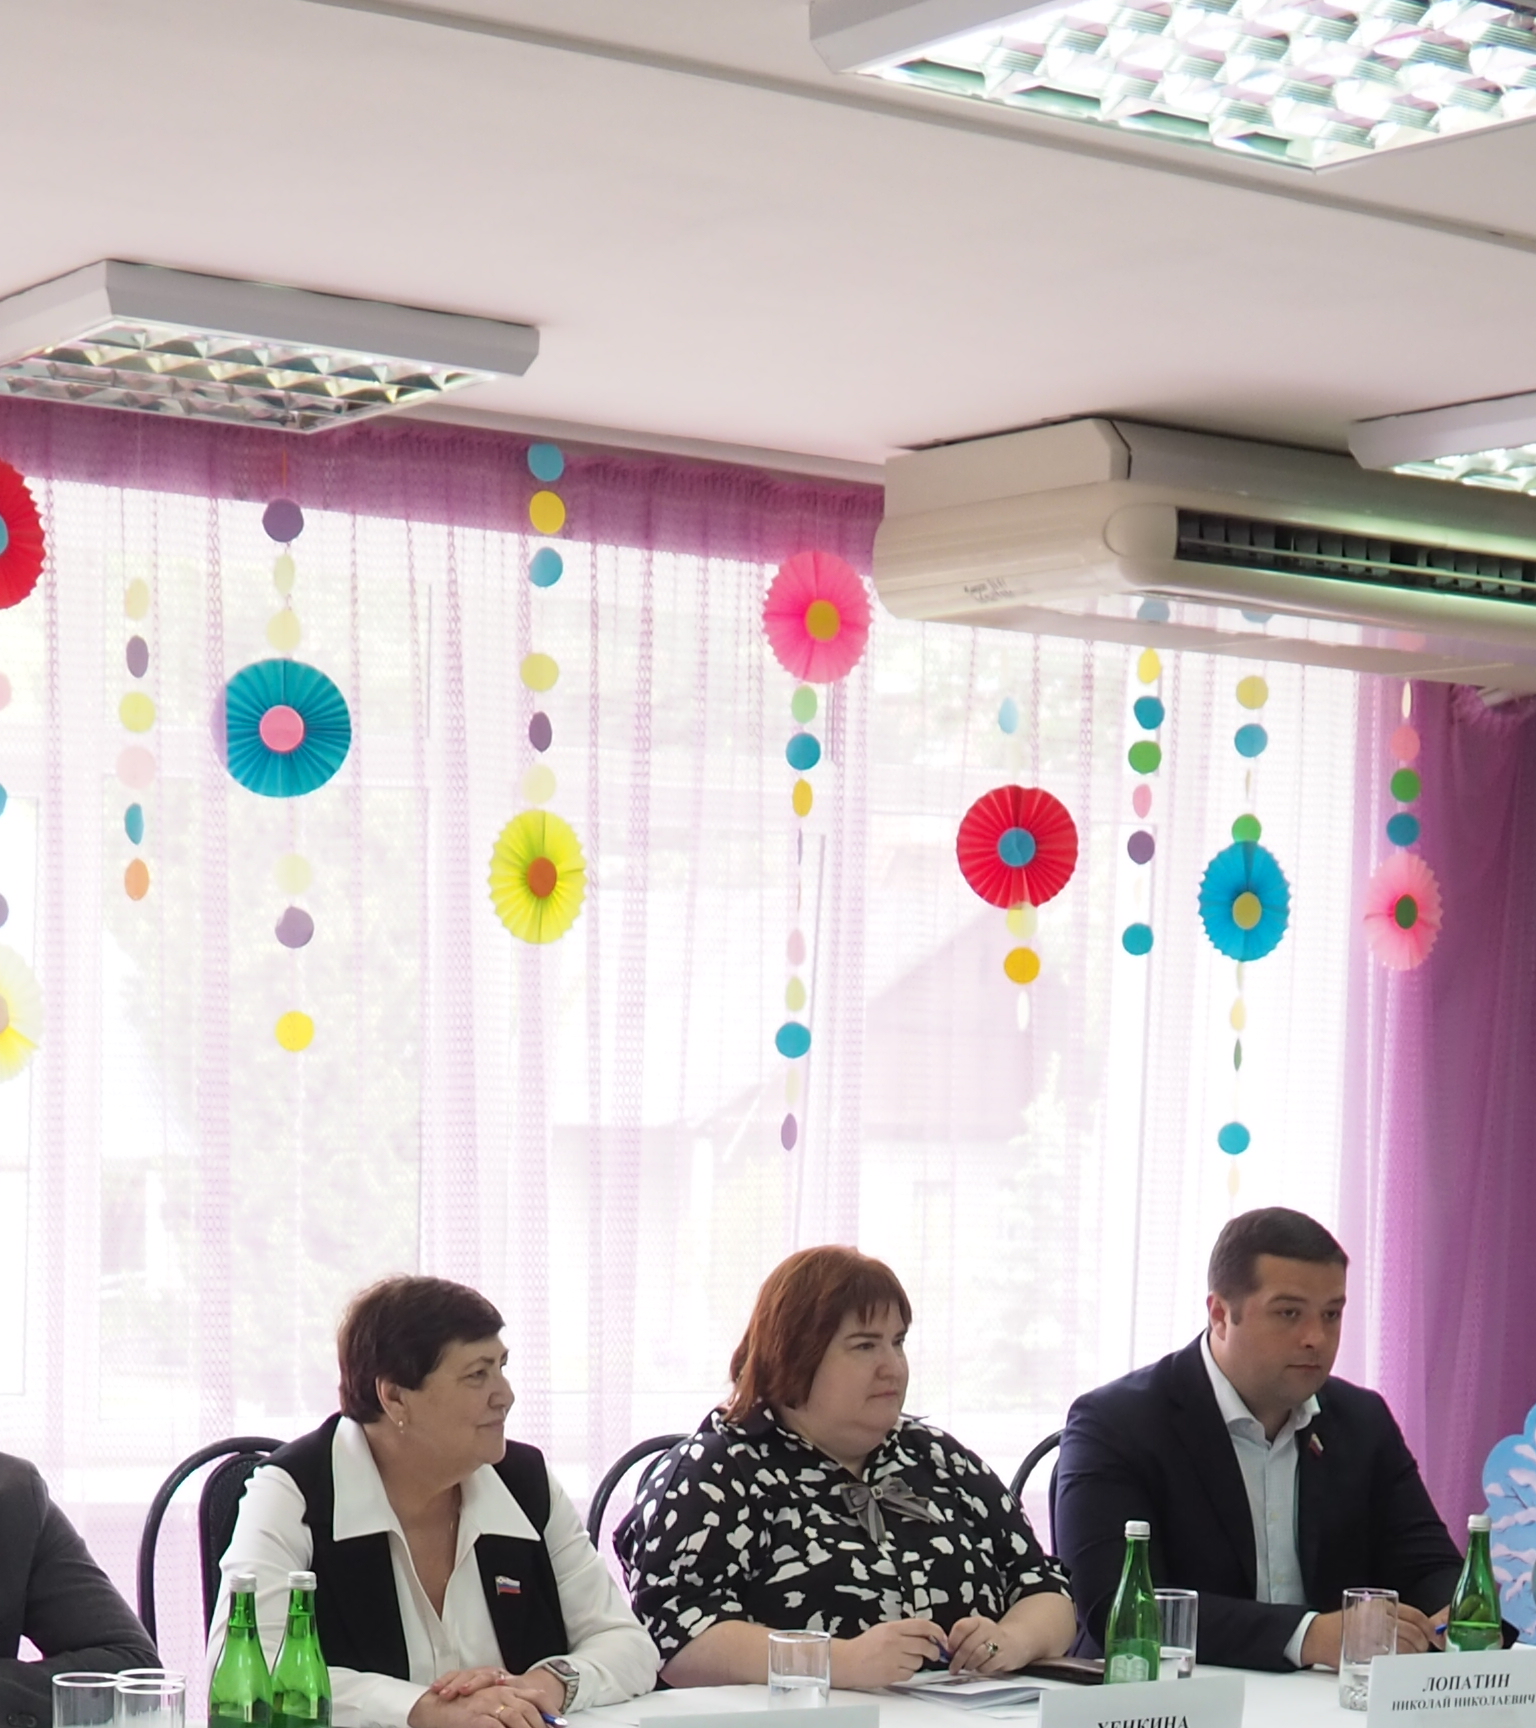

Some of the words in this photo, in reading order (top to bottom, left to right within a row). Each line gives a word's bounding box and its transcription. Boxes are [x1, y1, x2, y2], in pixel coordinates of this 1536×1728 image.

[1422, 1673, 1511, 1693] ЛОПАТИН
[1392, 1694, 1451, 1711] НИКОЛАЙ
[1454, 1694, 1536, 1708] НИКОЛАЕВИЧ
